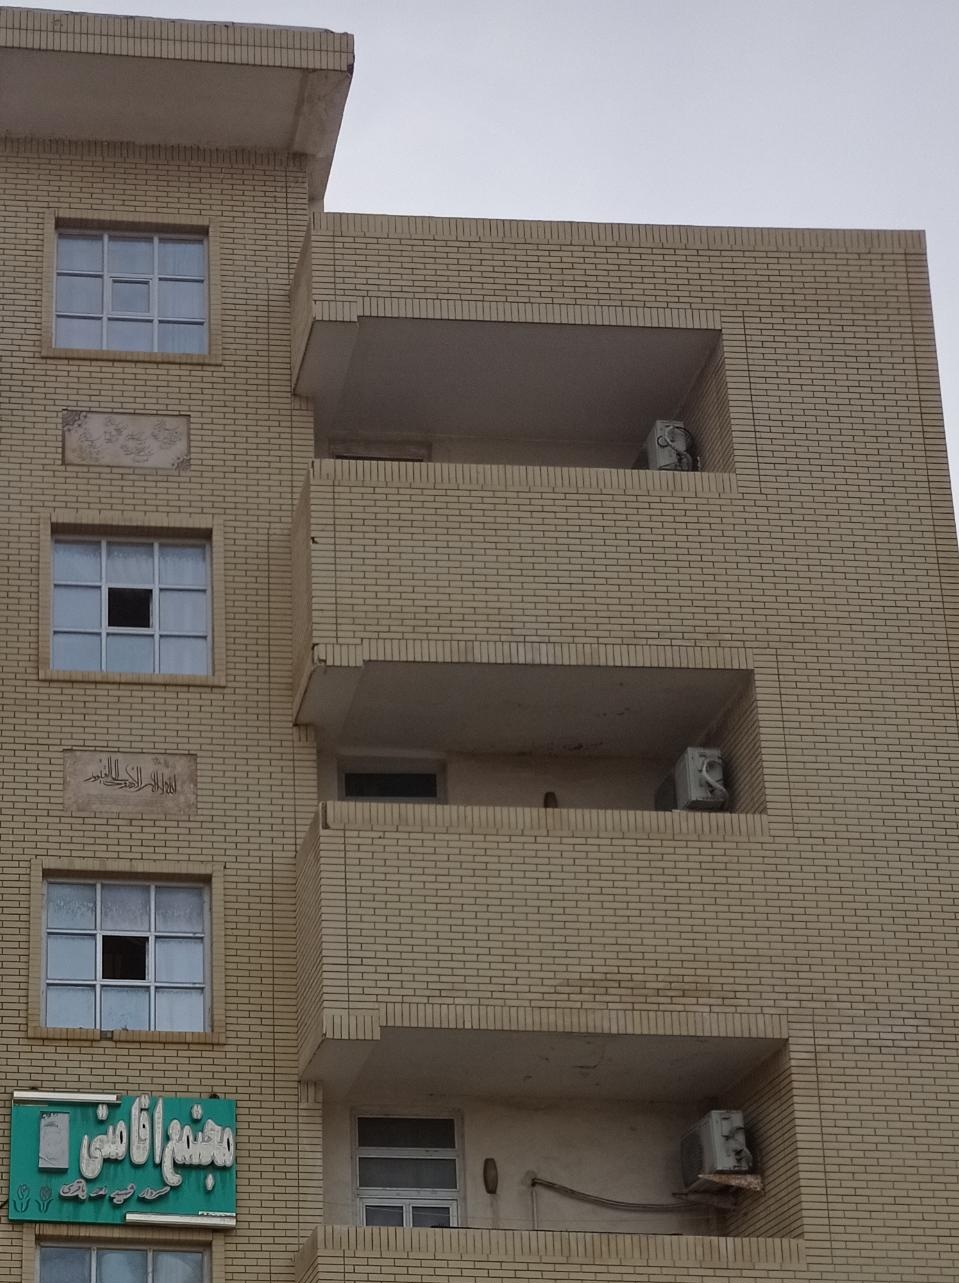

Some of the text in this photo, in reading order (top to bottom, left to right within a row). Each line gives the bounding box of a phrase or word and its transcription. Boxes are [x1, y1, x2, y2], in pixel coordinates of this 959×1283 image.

[79, 1093, 234, 1191] مجتمع اقامتی
[59, 1178, 87, 1200] باقری
[109, 1183, 137, 1205] شهید
[138, 1185, 171, 1201] سردار
